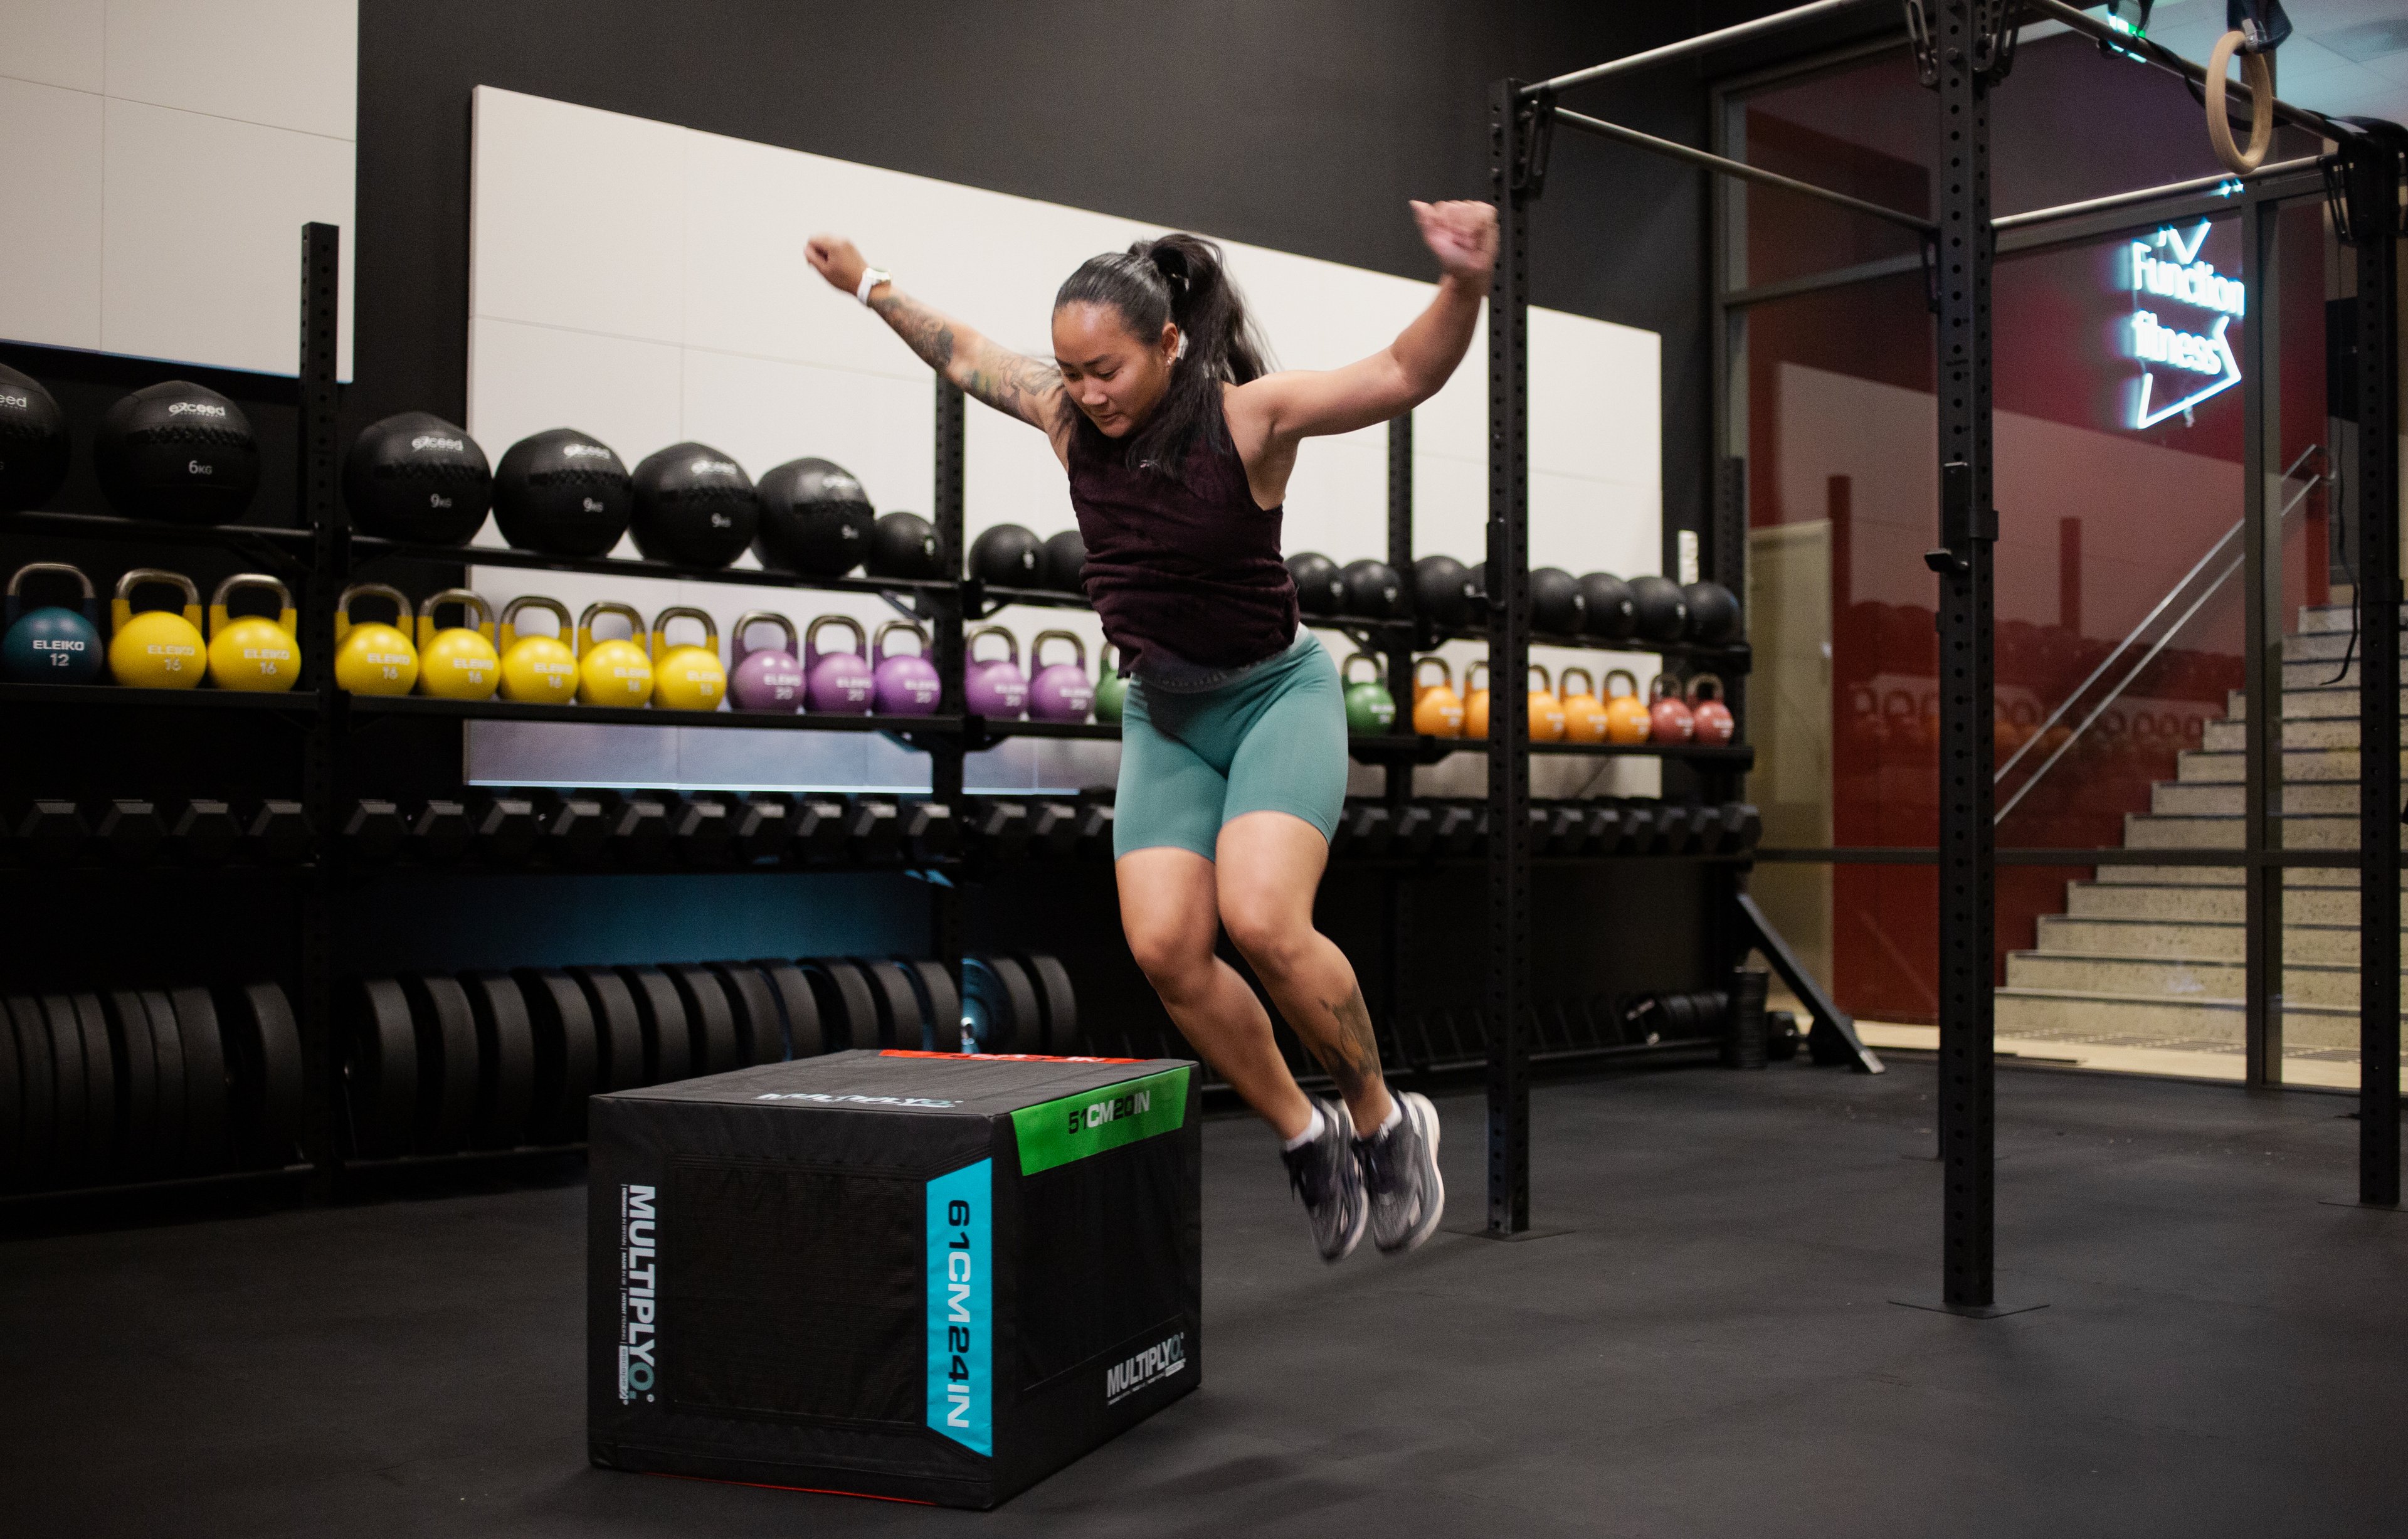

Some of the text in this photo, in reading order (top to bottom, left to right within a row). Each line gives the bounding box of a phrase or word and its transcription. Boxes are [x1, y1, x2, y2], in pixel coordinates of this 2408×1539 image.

[2131, 240, 2246, 316] Function
[2130, 309, 2222, 375] fitness
[0, 394, 27, 408] eed
[168, 402, 225, 417] exceed
[189, 460, 213, 475] 6KG
[33, 640, 85, 652] ELEIKO
[147, 644, 195, 656] ELEIKO
[50, 653, 69, 667] 12
[164, 657, 182, 672] 16
[260, 660, 277, 675] 16
[948, 1200, 971, 1428] 61CM24IN
